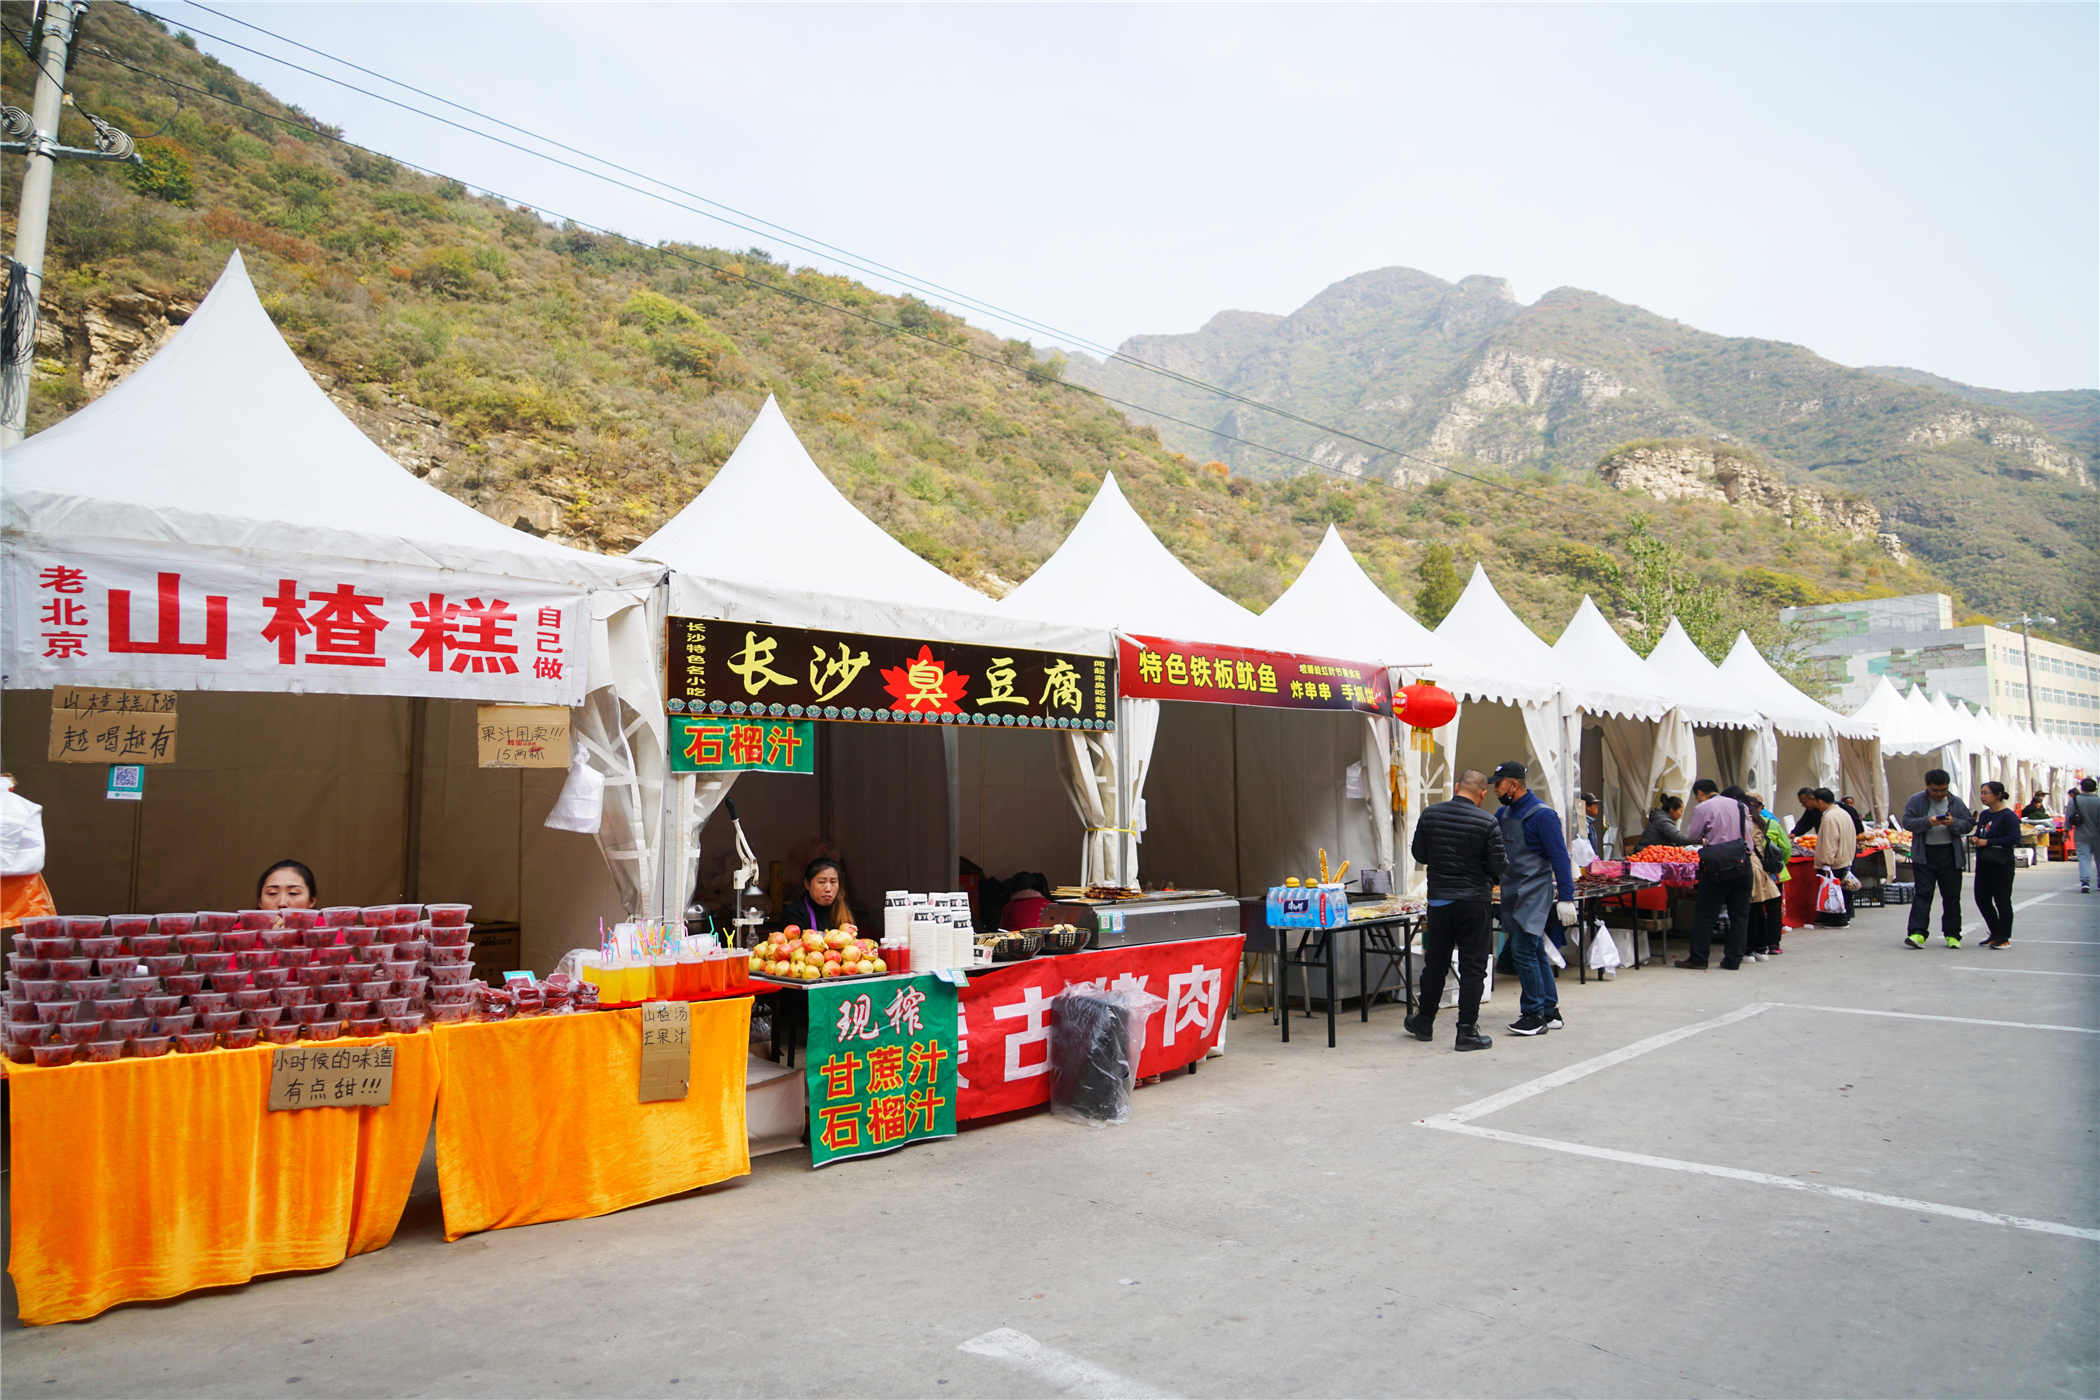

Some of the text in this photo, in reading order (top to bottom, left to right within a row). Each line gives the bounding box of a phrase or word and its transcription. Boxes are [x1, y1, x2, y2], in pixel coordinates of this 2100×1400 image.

[39, 565, 89, 659] 老北京
[107, 571, 520, 675] 山楂糕
[532, 605, 564, 682] 自己做
[686, 621, 707, 697] 长沙特色名小吃
[727, 630, 1084, 715] 长沙臭豆腐
[1138, 649, 1280, 695] 特色铁板鱿鱼
[1290, 679, 1332, 701] 炸串串
[1340, 683, 1376, 705] 手抓饼
[59, 724, 175, 759] 越喝越有
[683, 723, 803, 767] 石榴汁
[643, 1027, 687, 1047] 芒果汁
[836, 985, 927, 1044] 现榨
[273, 1047, 393, 1072] 小时候的味道
[820, 1039, 949, 1101] 甘蔗汁
[284, 1077, 382, 1105] 有点甜!!!
[819, 1087, 946, 1152] 石榴汁
